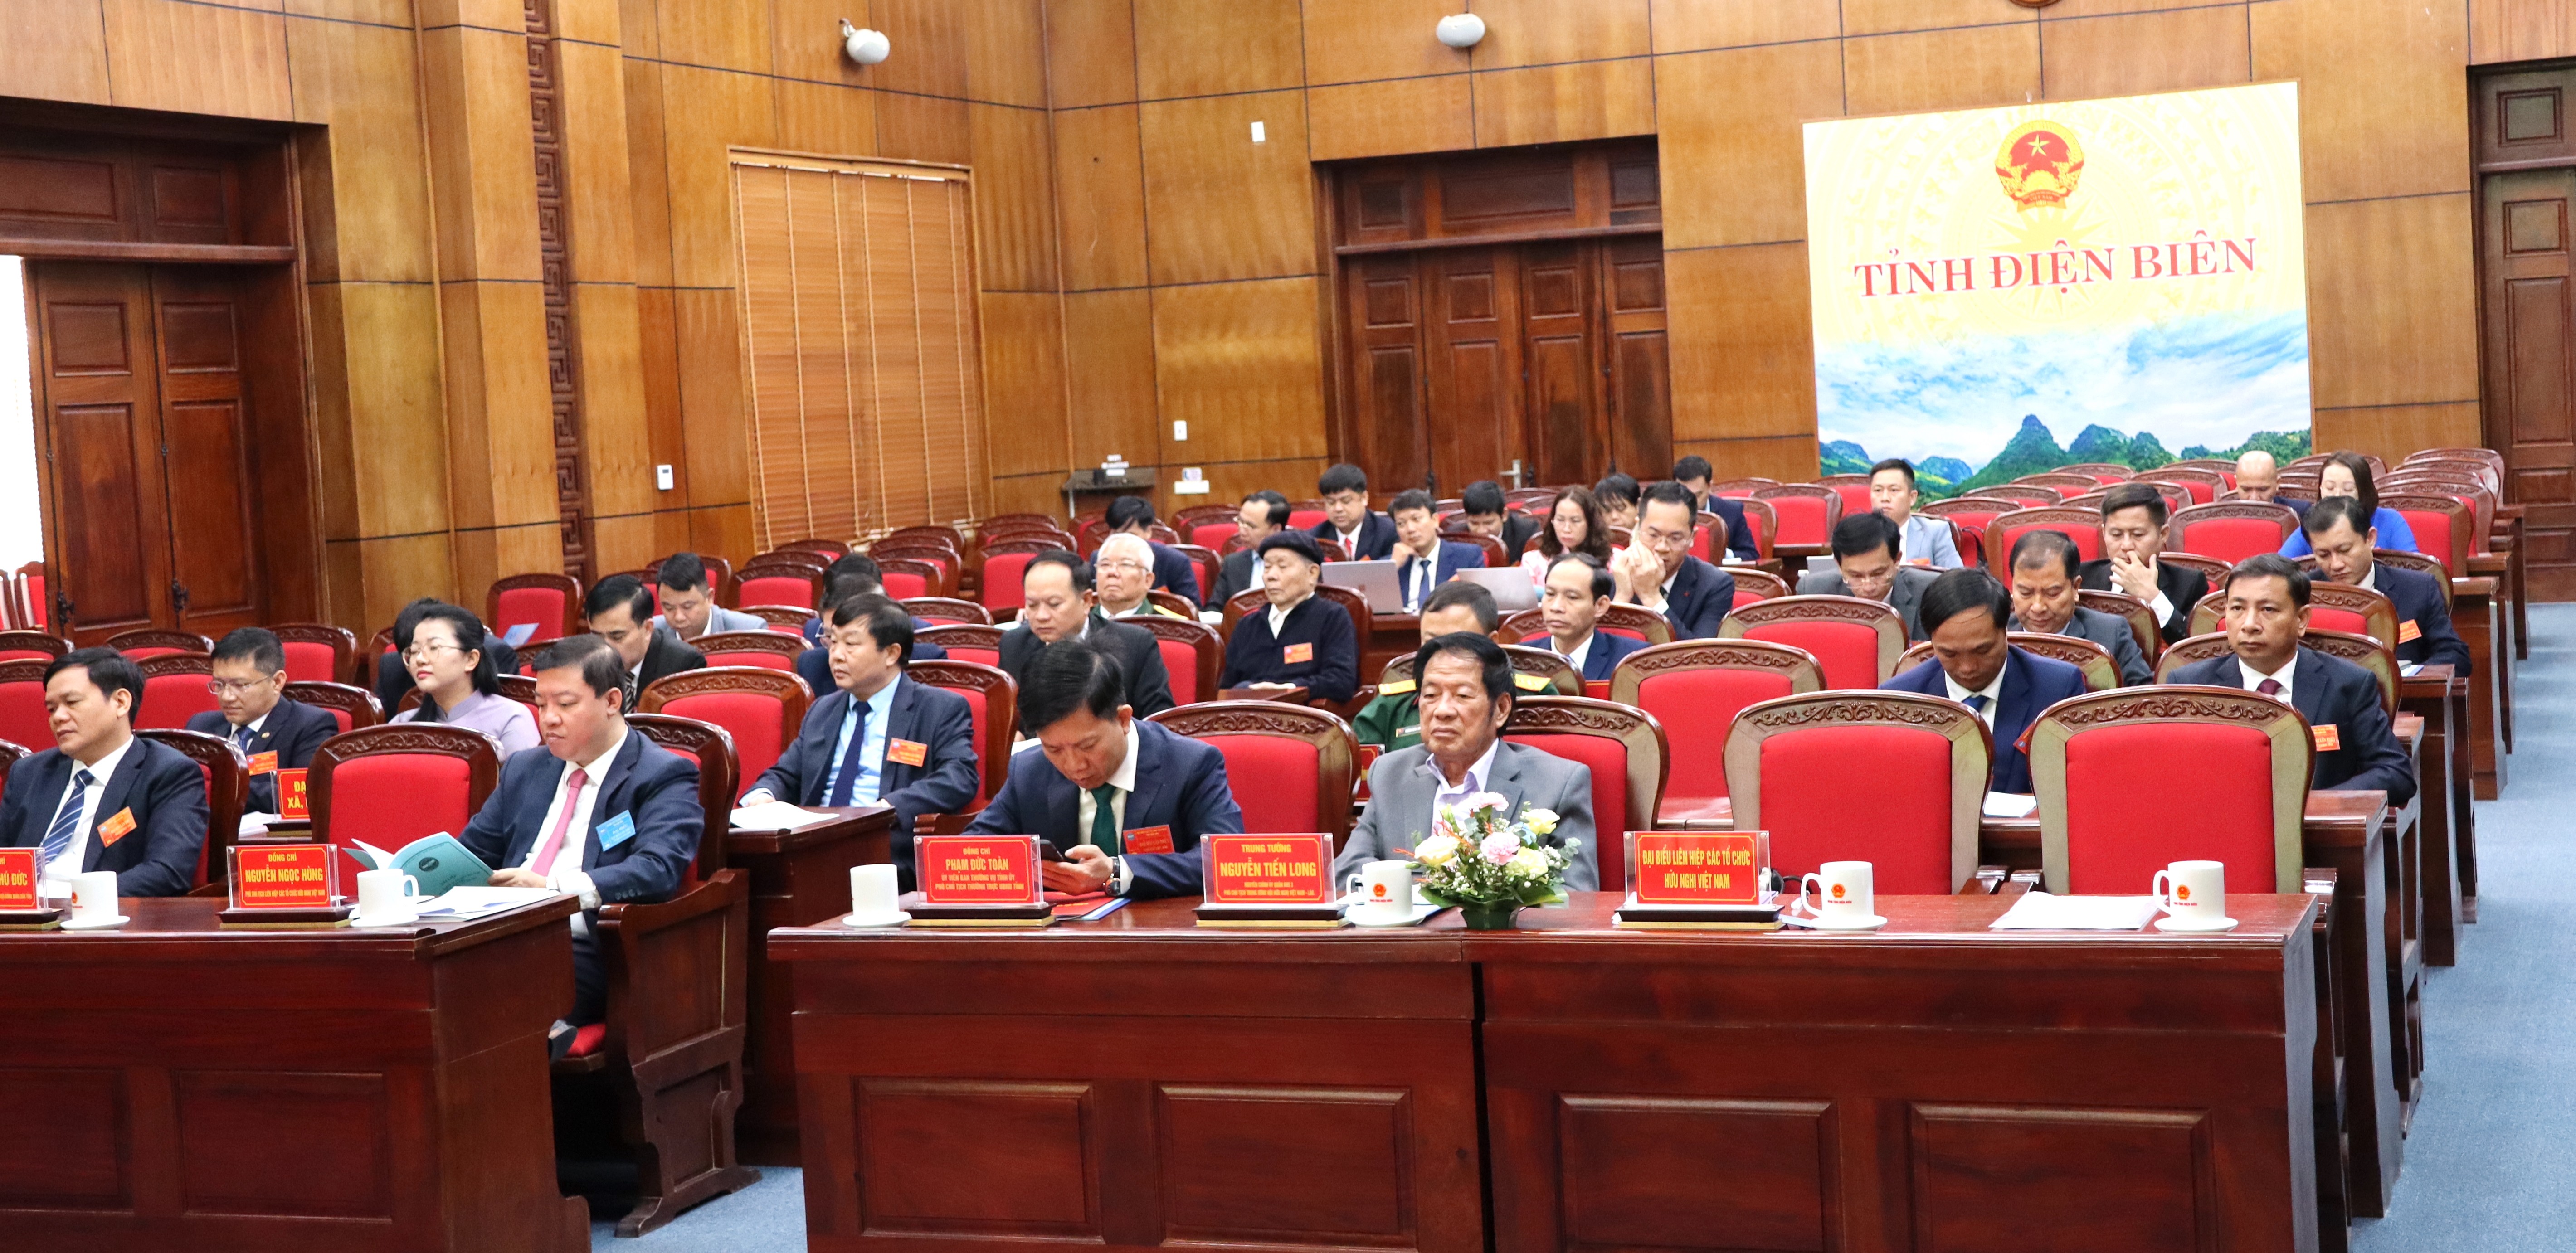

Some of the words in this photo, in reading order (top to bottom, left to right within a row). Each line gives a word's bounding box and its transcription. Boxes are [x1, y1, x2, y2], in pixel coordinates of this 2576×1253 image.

[1855, 248, 1976, 297] TỈNH
[1989, 240, 2115, 294] ĐIỆN
[2129, 230, 2257, 279] BIÊN
[294, 781, 306, 794] ĐẠ
[287, 795, 303, 809] XÃ,
[1241, 844, 1266, 853] TRUNG
[1267, 842, 1291, 853] TƯỚNG
[286, 852, 297, 861] CHÍ
[945, 859, 969, 873] PHẠM
[970, 856, 986, 870] ĐỨC
[988, 856, 1009, 870] TOÀN
[1642, 850, 1654, 868] ĐẠI
[1656, 844, 1671, 865] BIỂU
[1673, 847, 1688, 865] LIÊN
[1689, 847, 1705, 869] HIỆP
[1706, 847, 1720, 866] CÁC
[1722, 845, 1730, 865] TỔ
[1732, 846, 1751, 866] CHỨC
[245, 864, 277, 883] NGUYỄN
[278, 868, 300, 884] NGỌC
[301, 866, 323, 881] HÙNG
[1220, 857, 1261, 877] NGUYỄN
[1263, 857, 1286, 877] TIẾN
[1289, 862, 1316, 877] LONG
[0, 870, 10, 886] HÚ
[11, 869, 28, 886] ĐỨC
[1664, 869, 1678, 888] HỮU
[1680, 873, 1696, 892] NGHỊ
[1698, 870, 1712, 892] VIỆT
[1714, 874, 1730, 889] NAM
